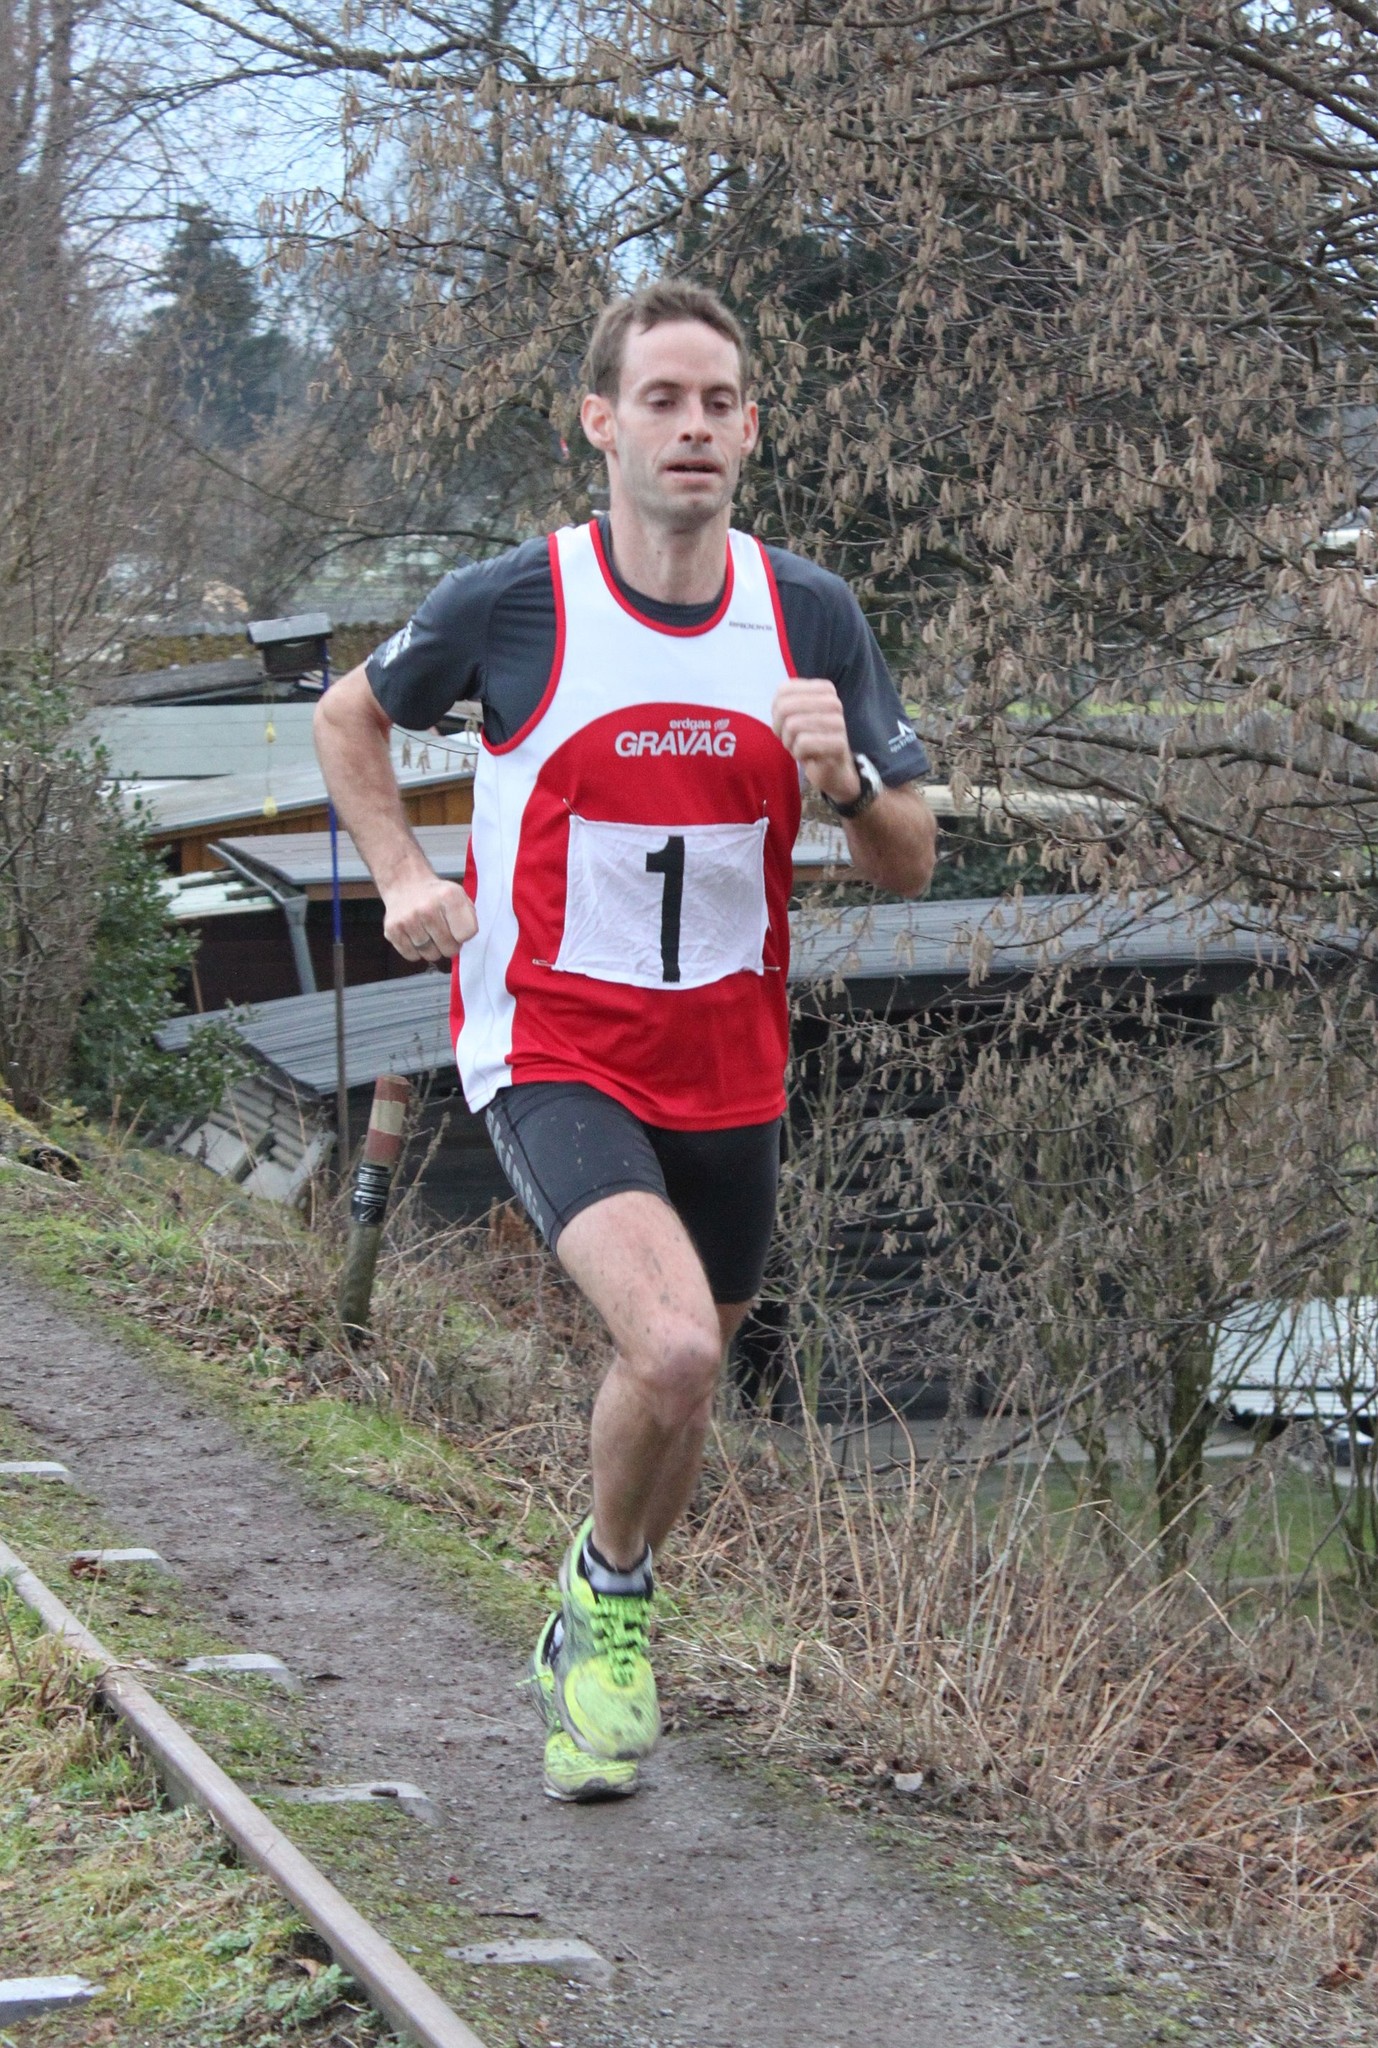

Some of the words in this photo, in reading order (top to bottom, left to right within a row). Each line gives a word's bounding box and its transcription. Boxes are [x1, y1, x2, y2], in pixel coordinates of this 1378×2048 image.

[669, 718, 711, 731] erdgas
[615, 731, 736, 757] GRAVAG
[646, 835, 685, 982] 1
